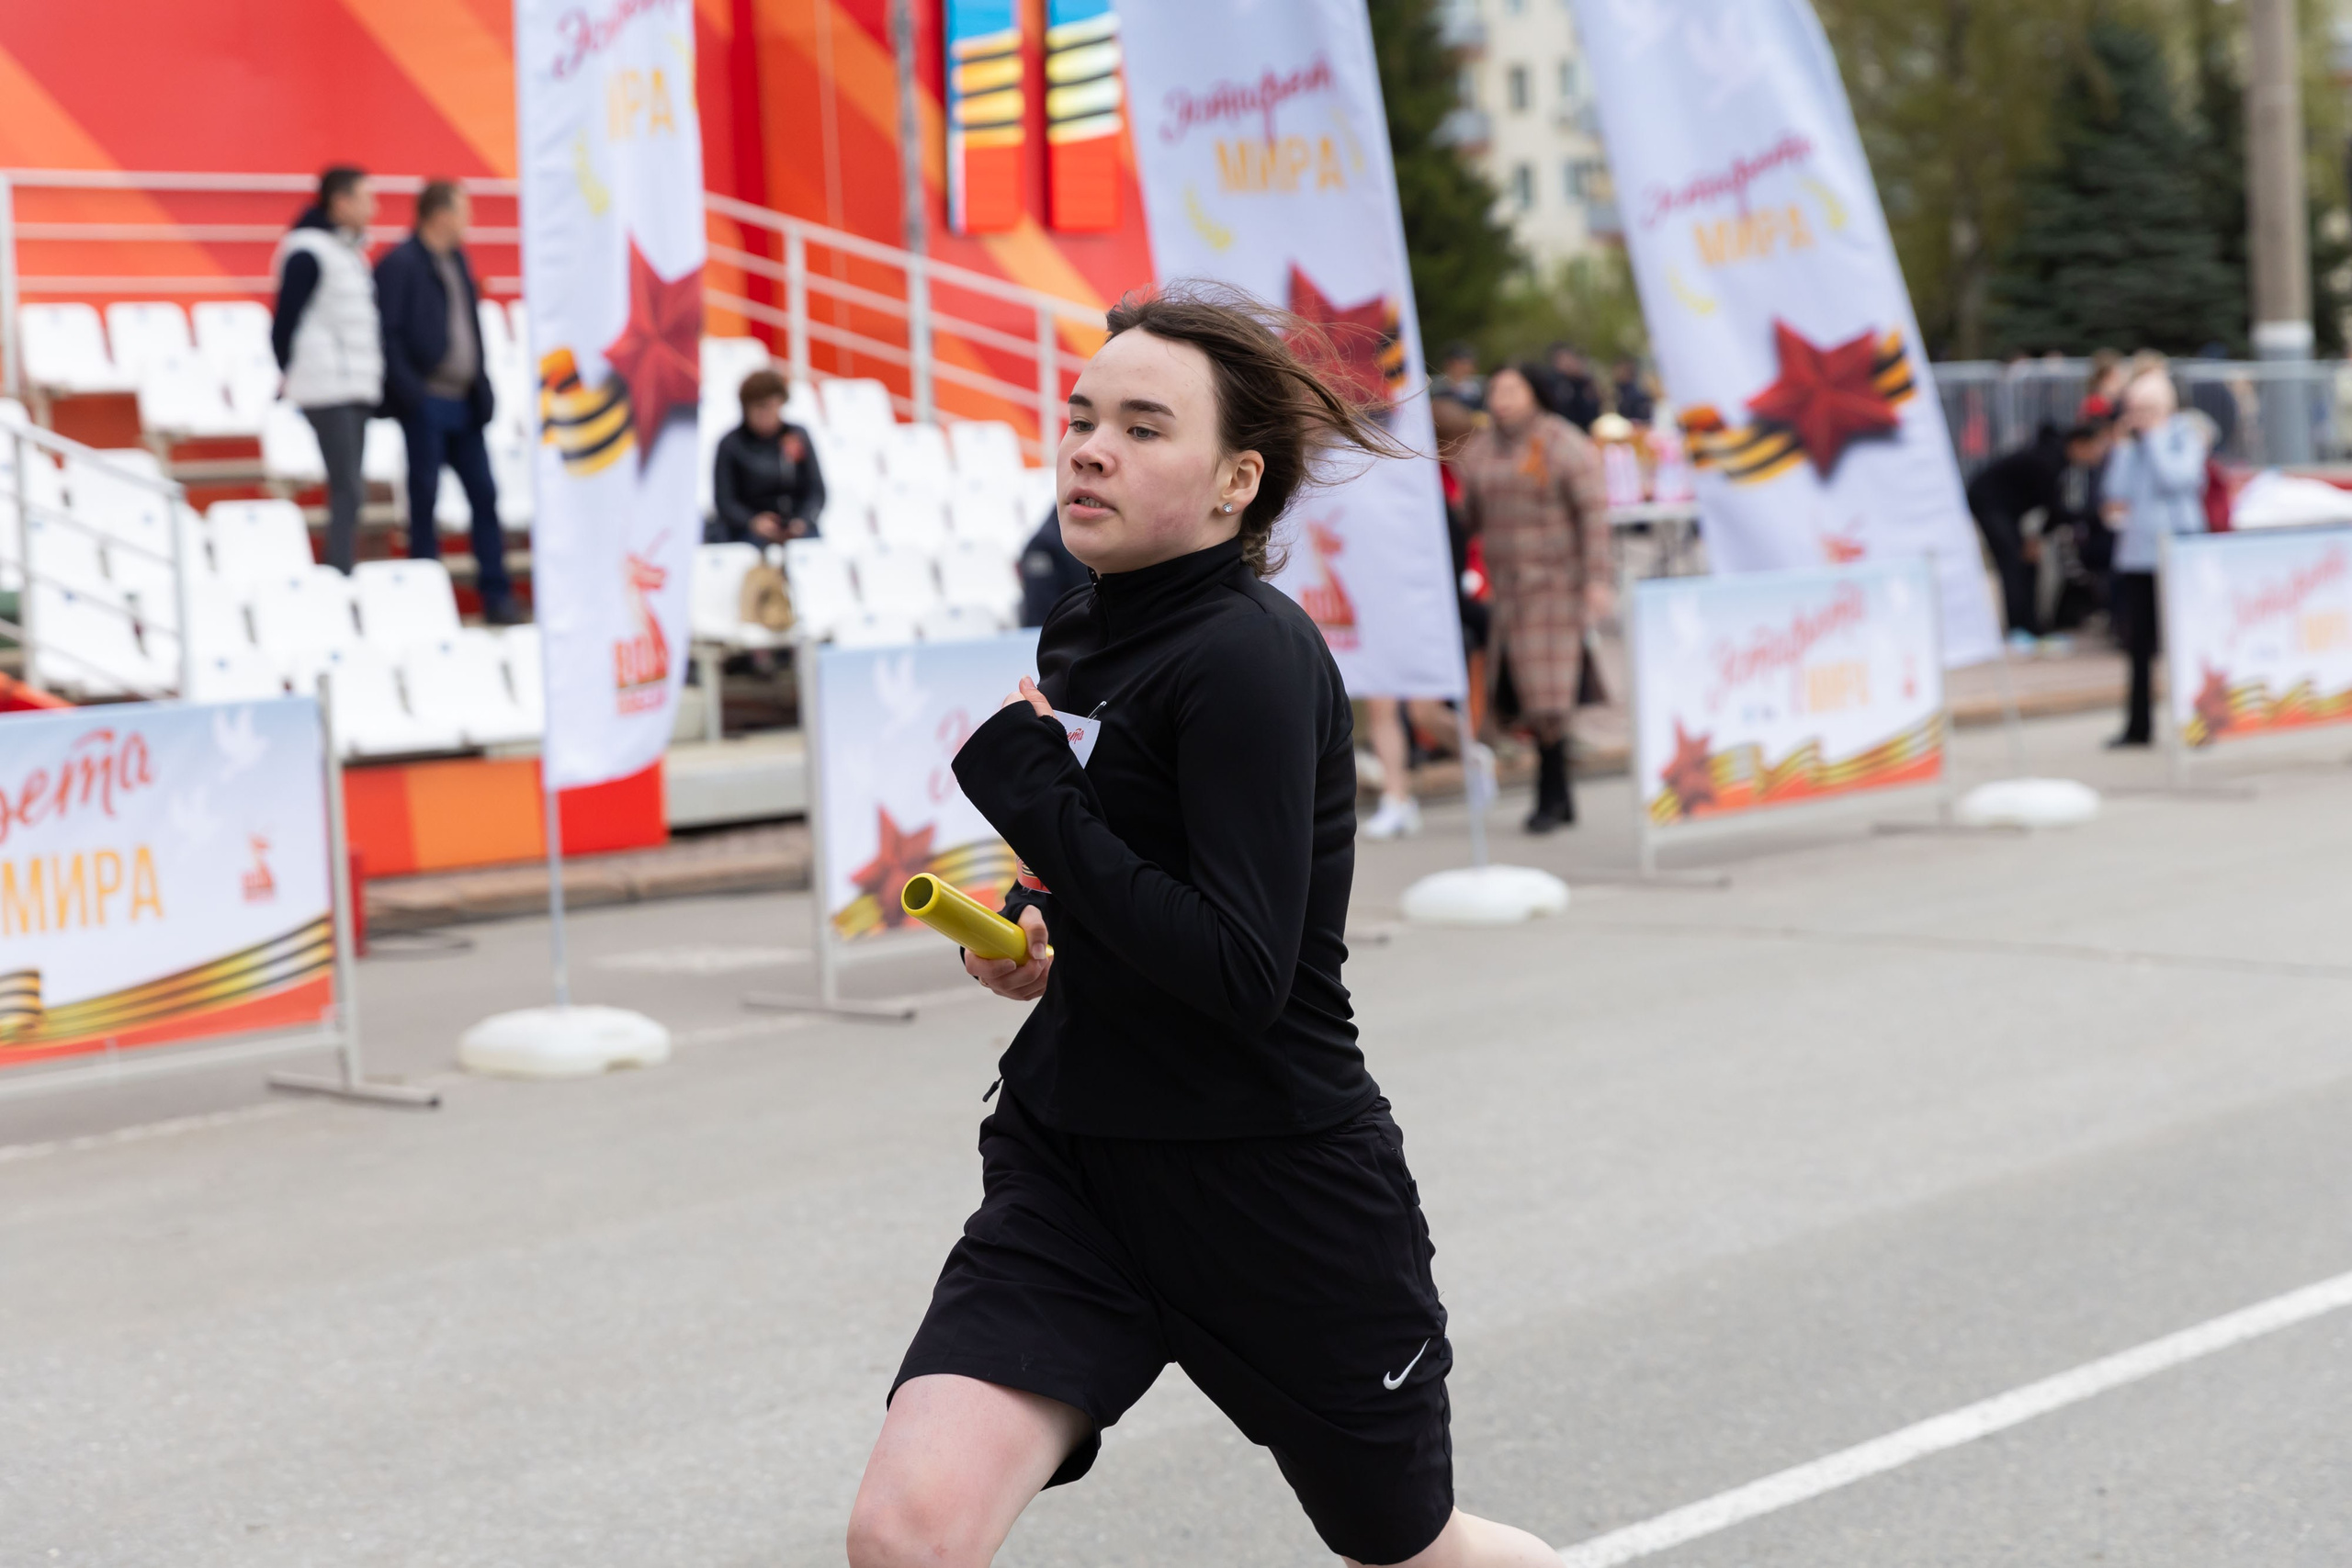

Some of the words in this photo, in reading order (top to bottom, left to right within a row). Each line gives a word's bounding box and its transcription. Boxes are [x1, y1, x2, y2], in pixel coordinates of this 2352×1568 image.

[1215, 136, 1345, 191] МИРА
[1693, 202, 1814, 264] МИРА
[2, 845, 163, 933] МИРА
